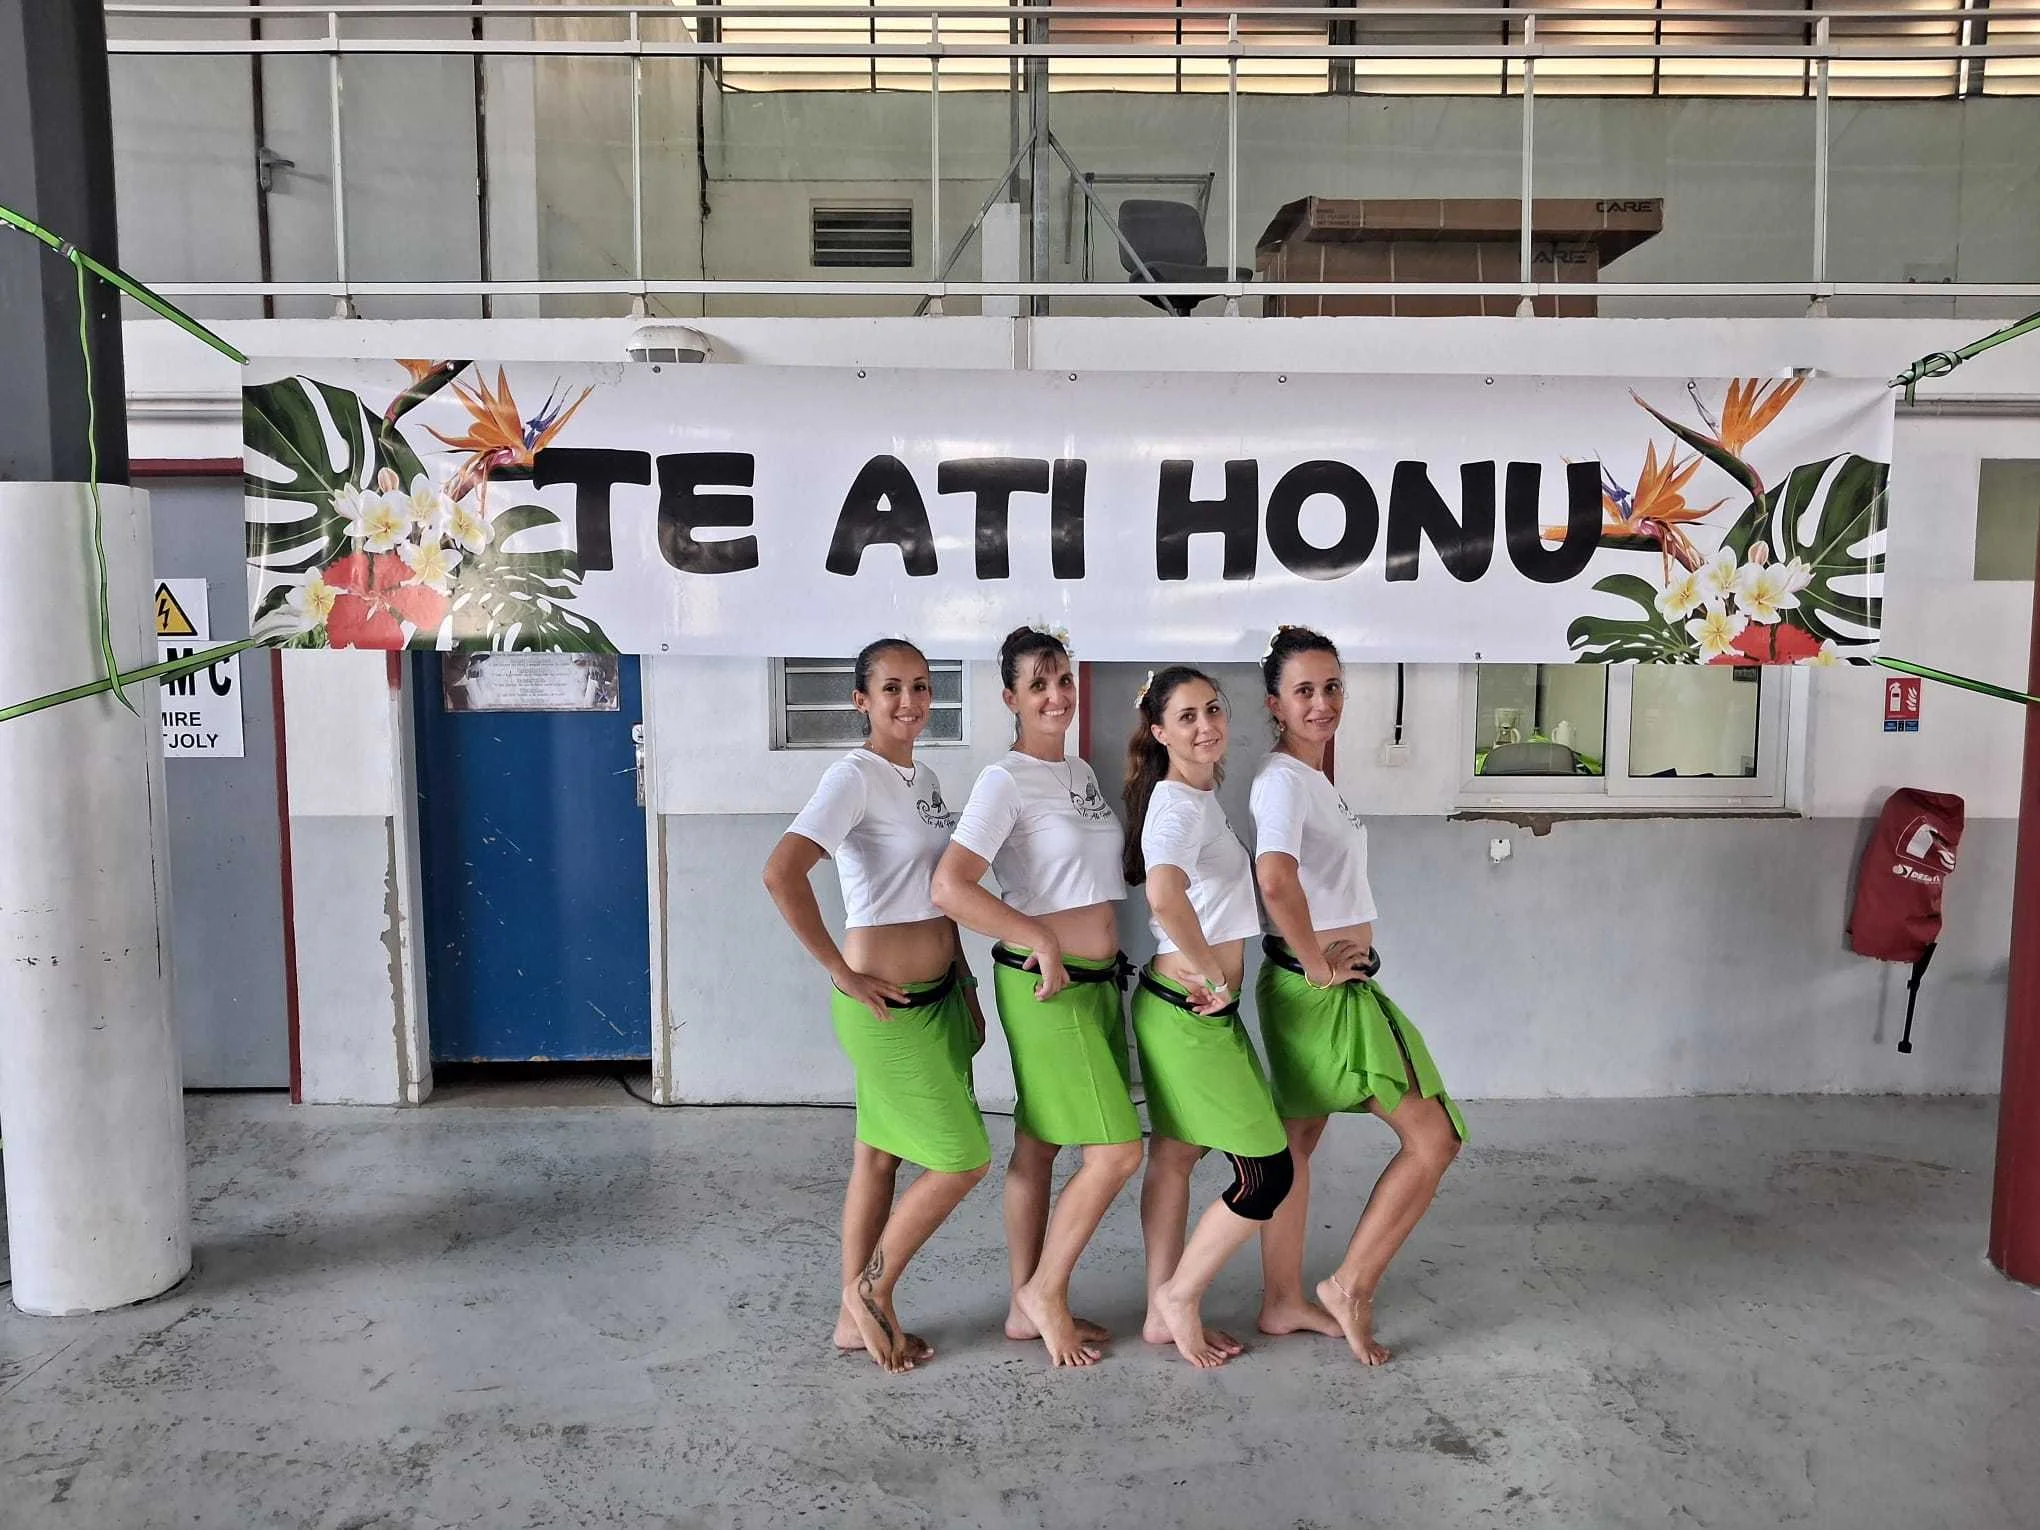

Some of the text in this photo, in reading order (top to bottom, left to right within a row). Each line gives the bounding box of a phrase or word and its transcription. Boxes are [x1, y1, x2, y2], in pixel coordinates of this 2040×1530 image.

[1596, 201, 1652, 213] CARE
[1518, 251, 1588, 264] ARE
[533, 447, 1600, 583] TE ATI HONU
[168, 733, 219, 749] JOLY
